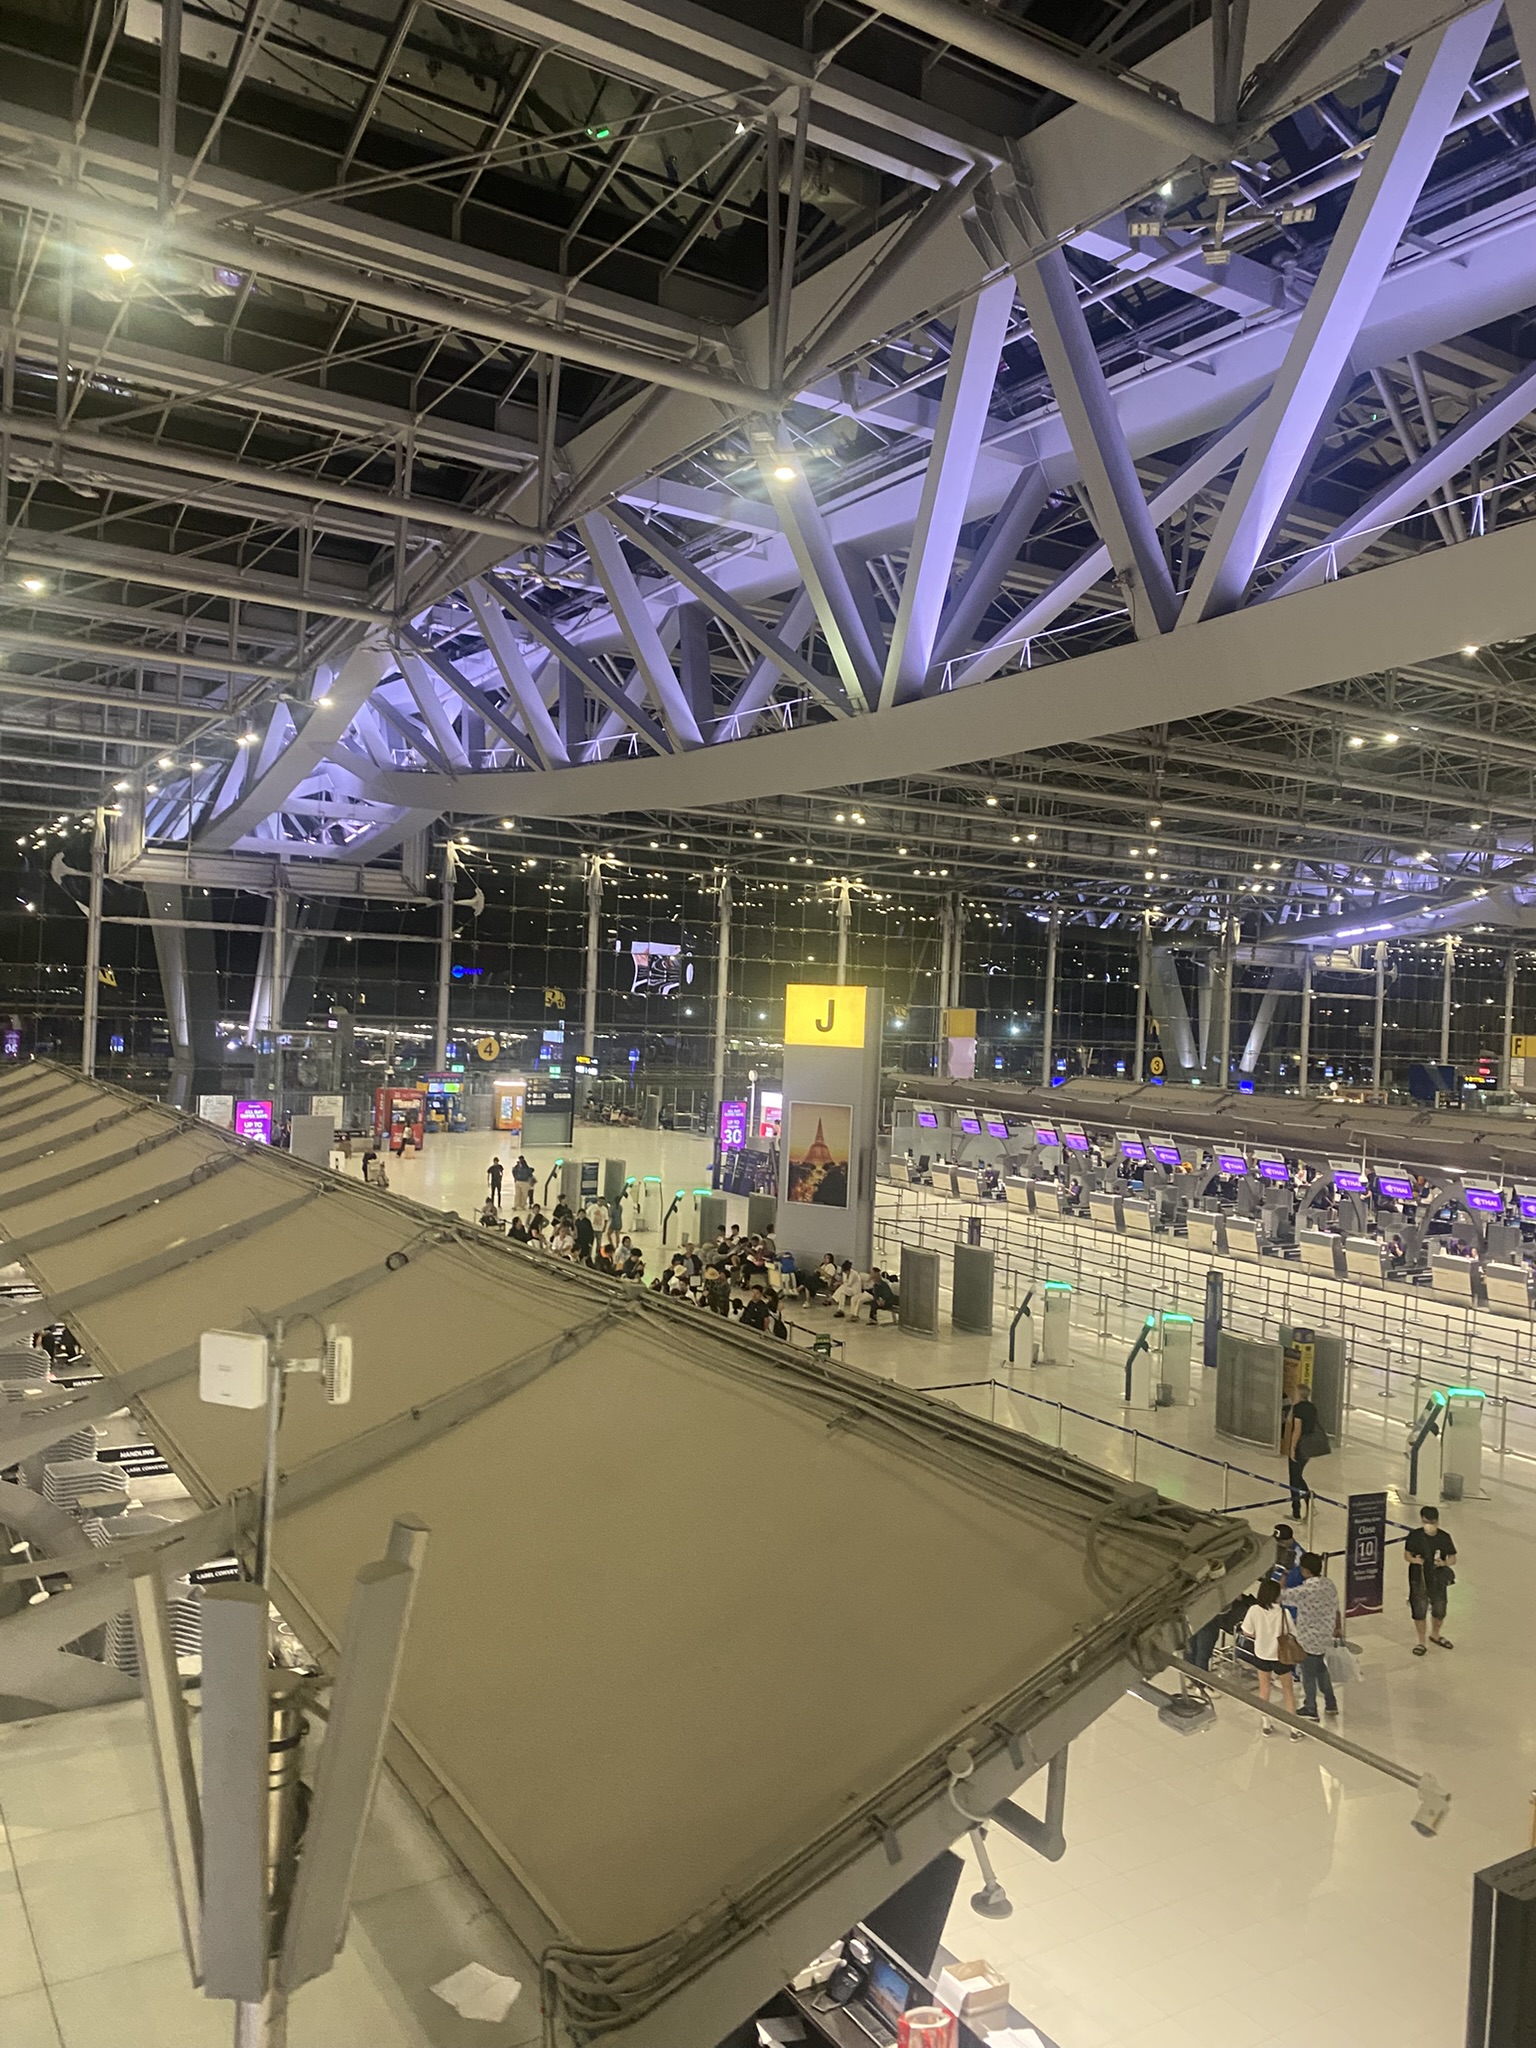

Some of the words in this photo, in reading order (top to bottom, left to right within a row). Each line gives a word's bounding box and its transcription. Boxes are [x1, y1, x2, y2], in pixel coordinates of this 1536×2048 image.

[815, 999, 835, 1033] J
[483, 1042, 494, 1057] 4
[1514, 1038, 1523, 1055] F
[1153, 1060, 1160, 1071] 3
[243, 1121, 253, 1129] UP
[254, 1121, 264, 1129] TO
[1271, 1168, 1285, 1176] THAI
[1346, 1179, 1361, 1187] THAI
[1392, 1186, 1408, 1194] THAI
[1481, 1198, 1498, 1207] THAI
[120, 1449, 155, 1458] HANDLING
[1358, 1526, 1376, 1534] Close
[1358, 1541, 1374, 1557] 10
